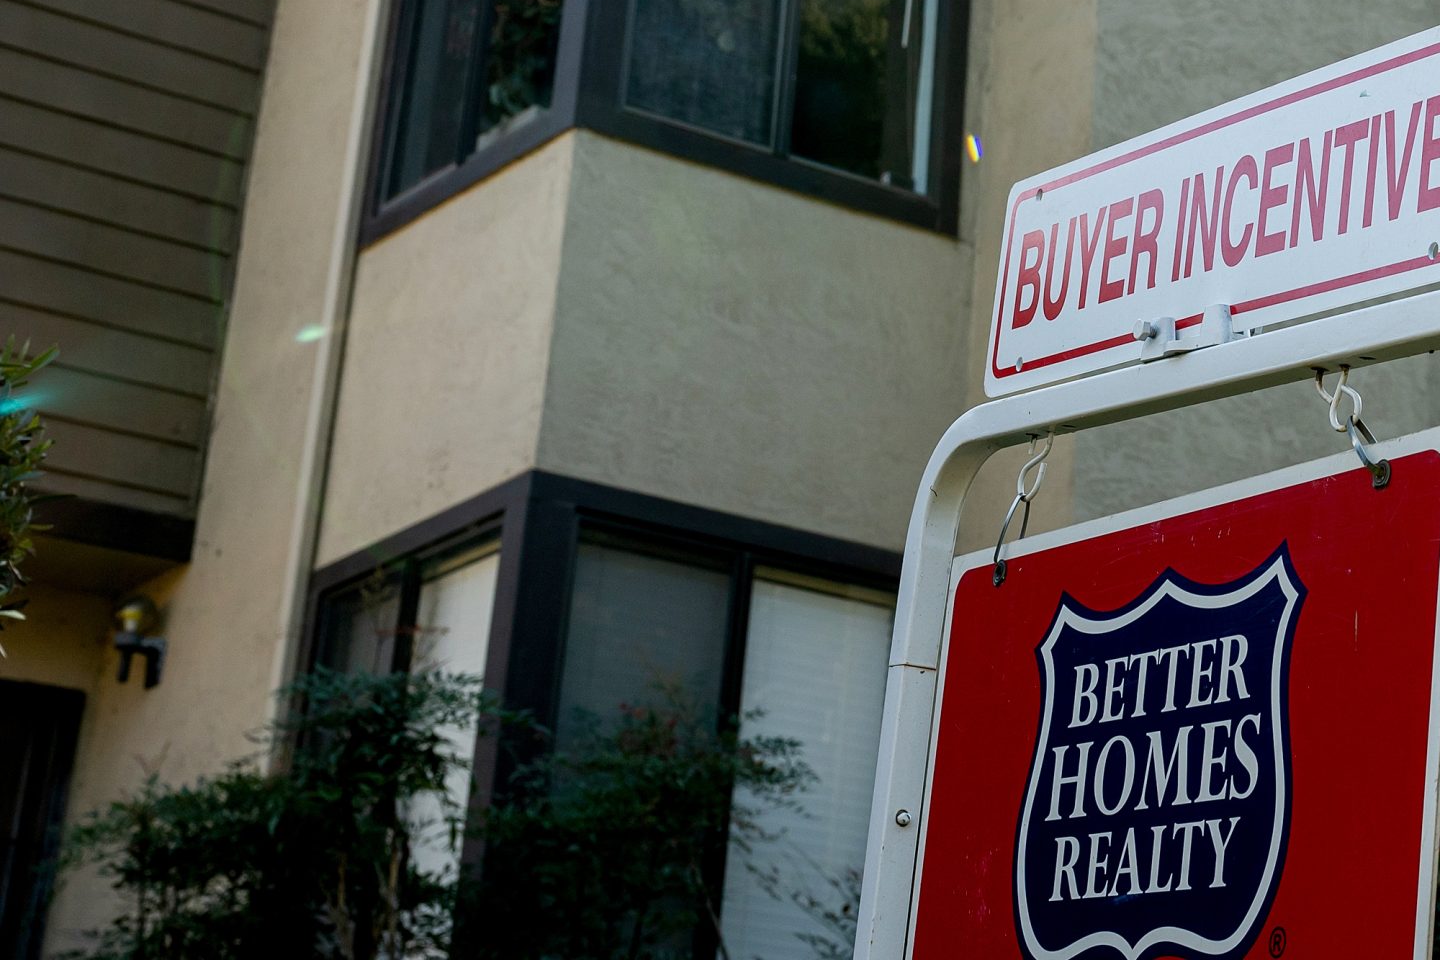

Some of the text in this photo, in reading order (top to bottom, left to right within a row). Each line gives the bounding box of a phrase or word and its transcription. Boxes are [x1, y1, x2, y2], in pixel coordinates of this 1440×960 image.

[1013, 188, 1164, 329] BUYER
[1069, 634, 1250, 728] BETTER
[1045, 713, 1261, 821] HOMES
[1049, 816, 1241, 902] REALTY
